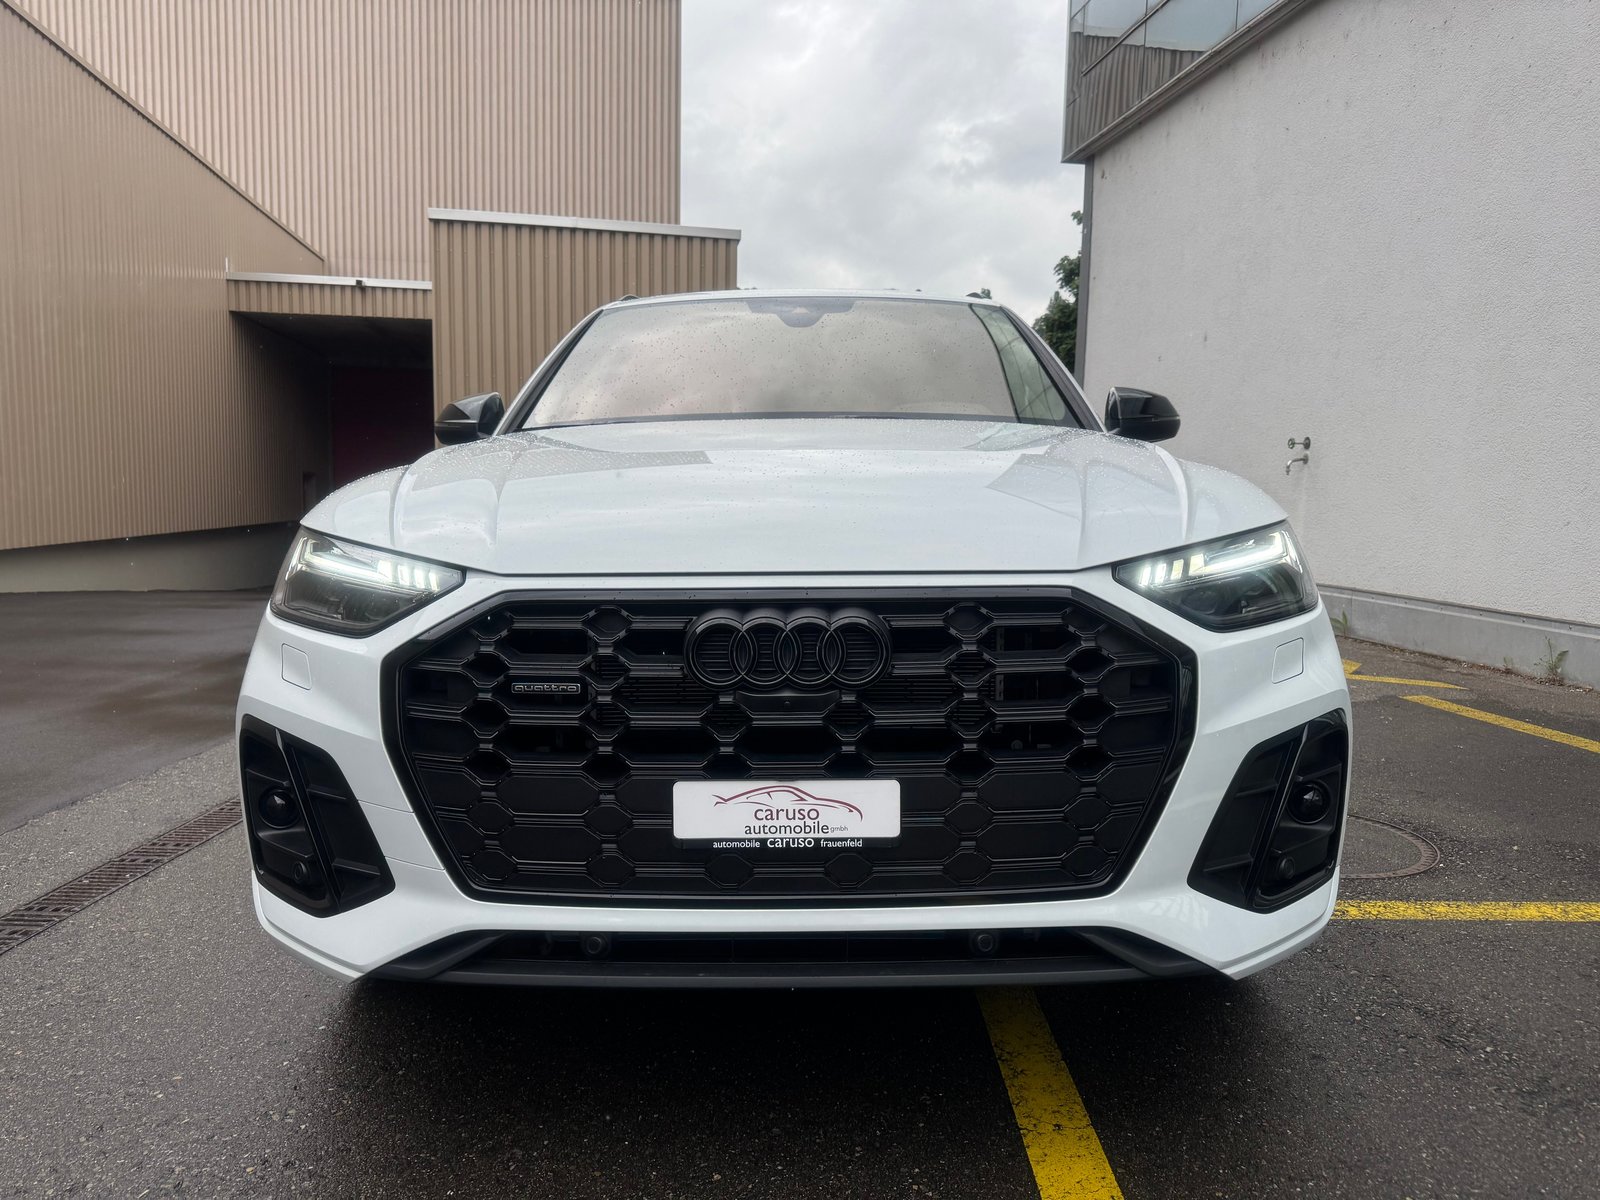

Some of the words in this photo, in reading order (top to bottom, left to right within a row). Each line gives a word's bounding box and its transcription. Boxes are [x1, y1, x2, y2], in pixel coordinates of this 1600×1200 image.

[514, 684, 577, 692] quattro
[754, 807, 820, 821] caruso
[744, 821, 829, 835] automobile
[830, 825, 848, 833] gmbh
[712, 839, 760, 848] automobile
[767, 837, 814, 848] caruso
[820, 839, 862, 848] frauenfeld
